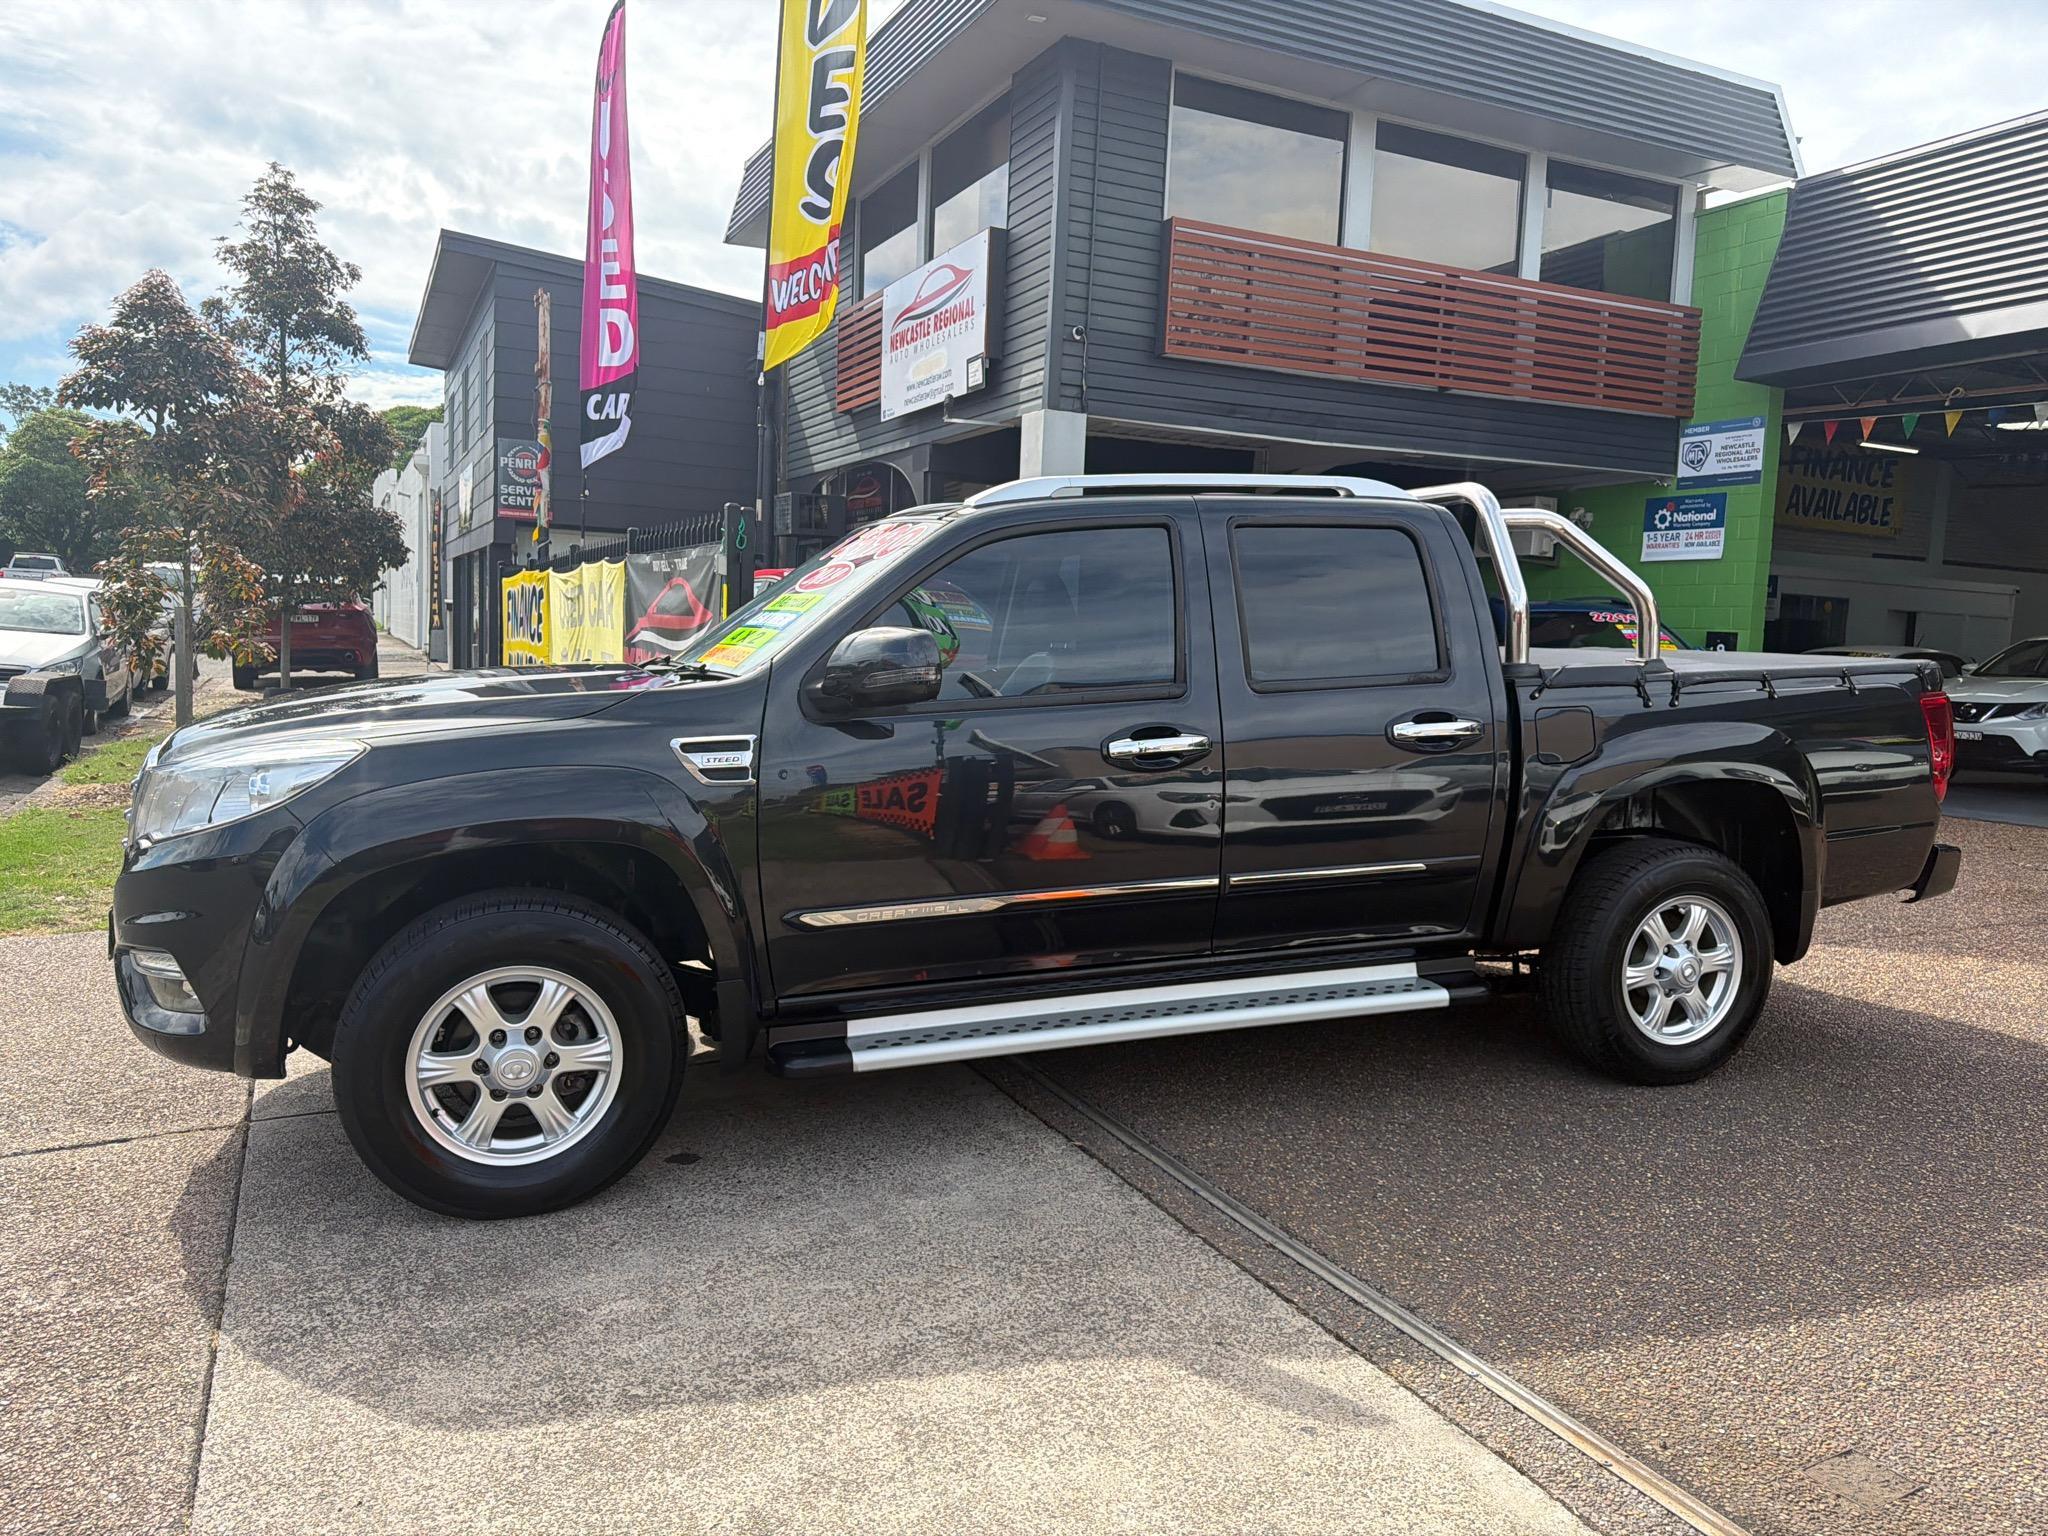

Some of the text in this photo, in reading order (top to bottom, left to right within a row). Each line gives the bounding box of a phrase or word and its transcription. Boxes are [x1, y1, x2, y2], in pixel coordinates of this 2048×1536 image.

[890, 295, 976, 353] NEWCASTLE REGIONAL
[889, 319, 976, 364] AUTO WHOLESALERS
[1684, 425, 1711, 434] MEMBER
[1714, 447, 1761, 458] REGIONAL AUTO
[1720, 442, 1756, 451] NEWCASTLE
[1688, 447, 1704, 465] MTA
[1716, 455, 1759, 464] WHOLESALERS
[1788, 446, 1899, 489] FINANCE
[1785, 484, 1895, 527] AVAILABLE
[1672, 508, 1717, 523] National
[1646, 532, 1681, 542] 1-5 YEAR
[1685, 531, 1704, 541] 24 HR
[1646, 542, 1681, 550] WARRANTIES
[588, 579, 615, 631] CAR
[506, 584, 545, 646] FINANCE
[705, 756, 740, 764] STEED
[856, 907, 919, 921] GREAT
